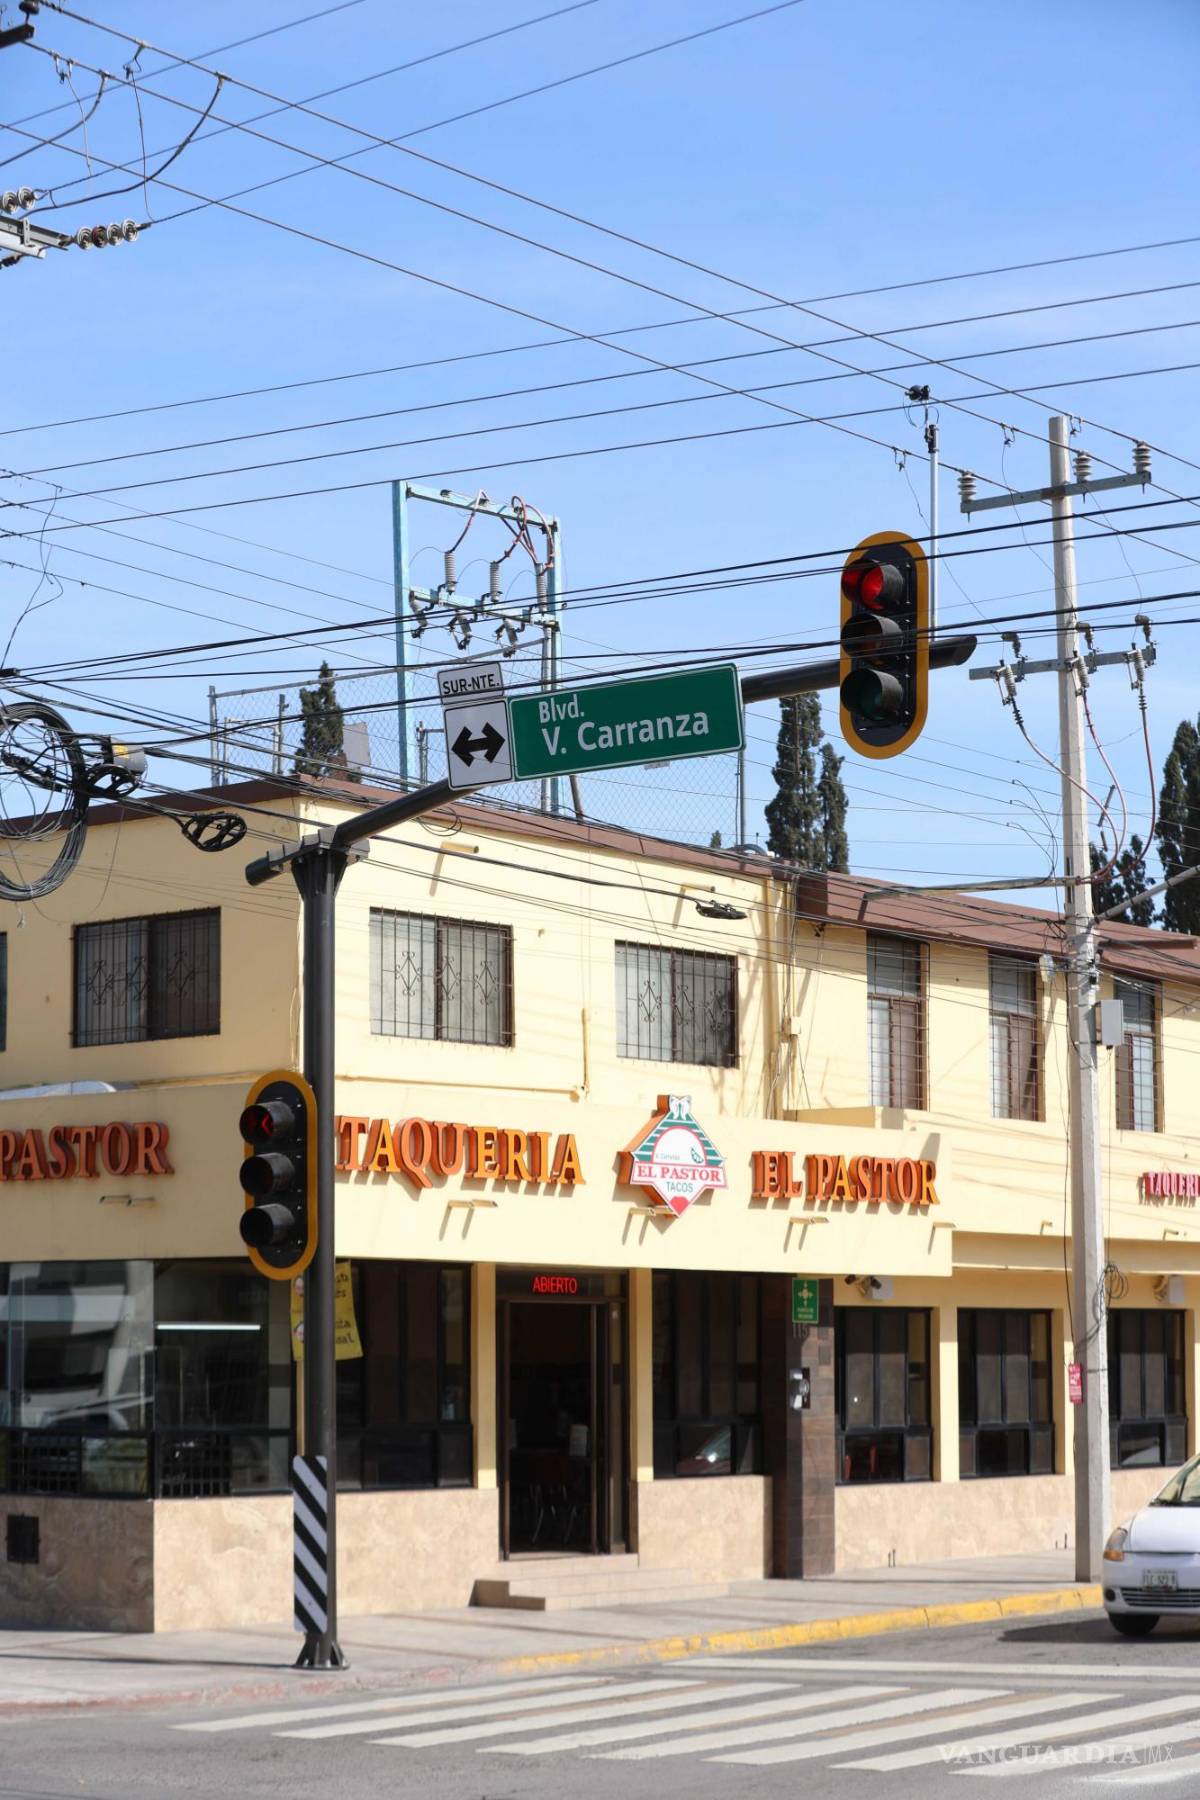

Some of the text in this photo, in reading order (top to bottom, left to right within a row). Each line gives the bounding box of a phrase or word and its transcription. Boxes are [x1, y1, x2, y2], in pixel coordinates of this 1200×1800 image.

[442, 673, 500, 695] SUR-NTE.
[538, 694, 585, 724] Blvd.
[541, 711, 710, 756] V. Carranza
[0, 1121, 174, 1181] PASTOR
[336, 1116, 586, 1189] TAQUERIA
[637, 1165, 721, 1182] EL PASTOR
[666, 1181, 694, 1193] TACOS
[751, 1151, 941, 1206] EL PASTOR
[532, 1275, 578, 1294] ABIERTO
